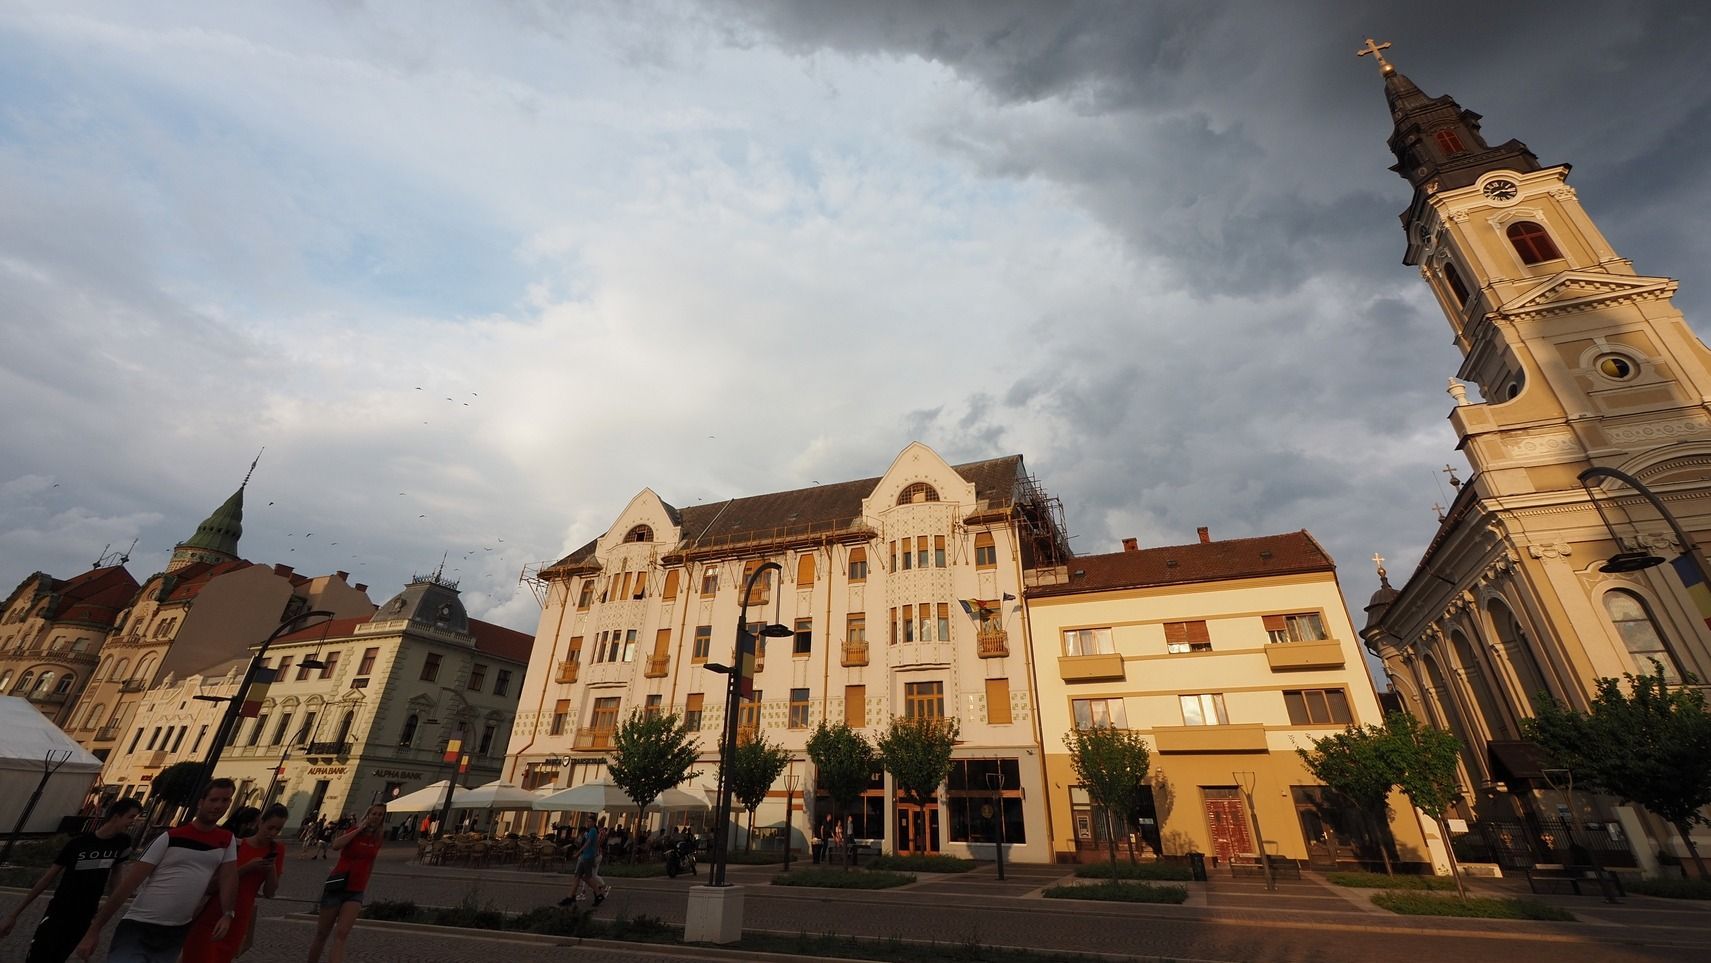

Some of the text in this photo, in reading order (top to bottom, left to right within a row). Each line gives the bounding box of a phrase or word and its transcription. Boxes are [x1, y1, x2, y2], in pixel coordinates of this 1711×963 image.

[307, 767, 348, 775] ALPHA BANK
[374, 769, 422, 780] ALPHA BANK
